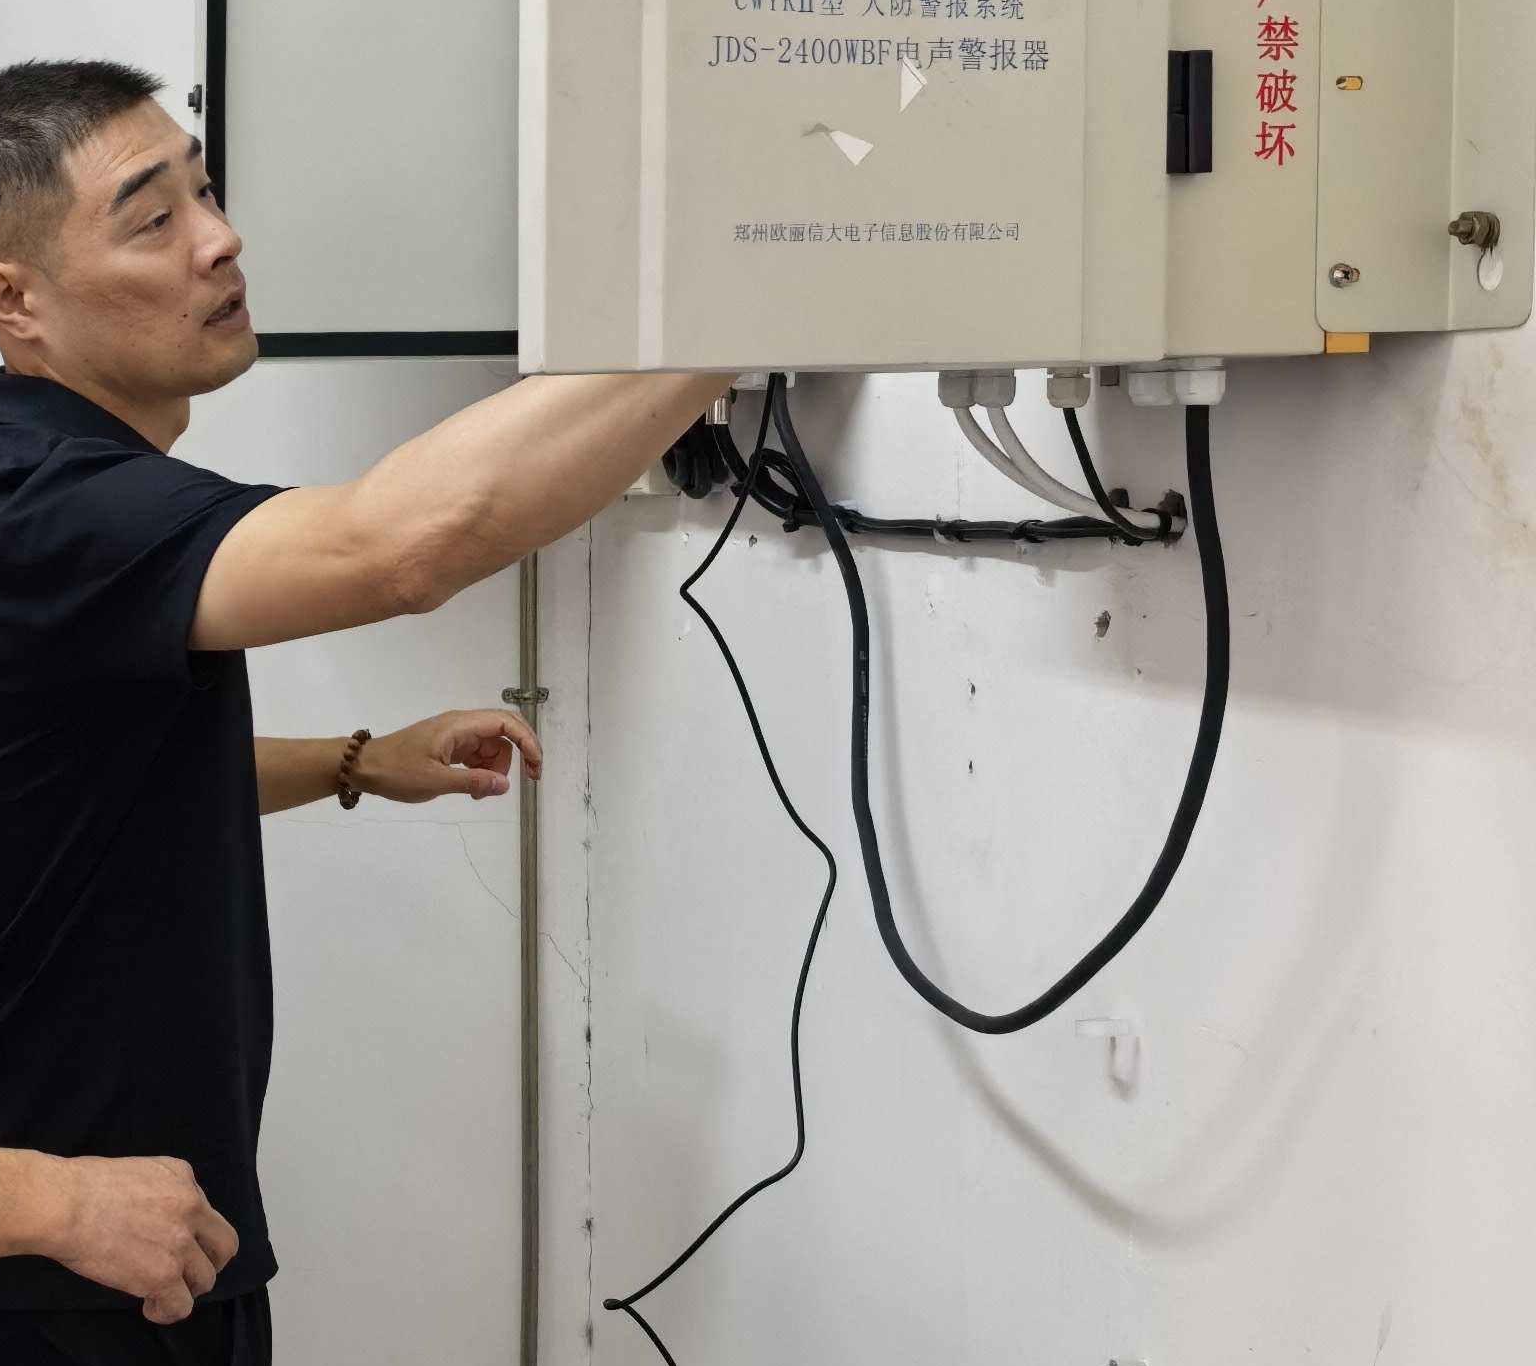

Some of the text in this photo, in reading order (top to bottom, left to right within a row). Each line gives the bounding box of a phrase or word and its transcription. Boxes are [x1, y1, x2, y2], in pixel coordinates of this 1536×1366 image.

[708, 34, 1050, 72] JDS-2400WBF电声警报器
